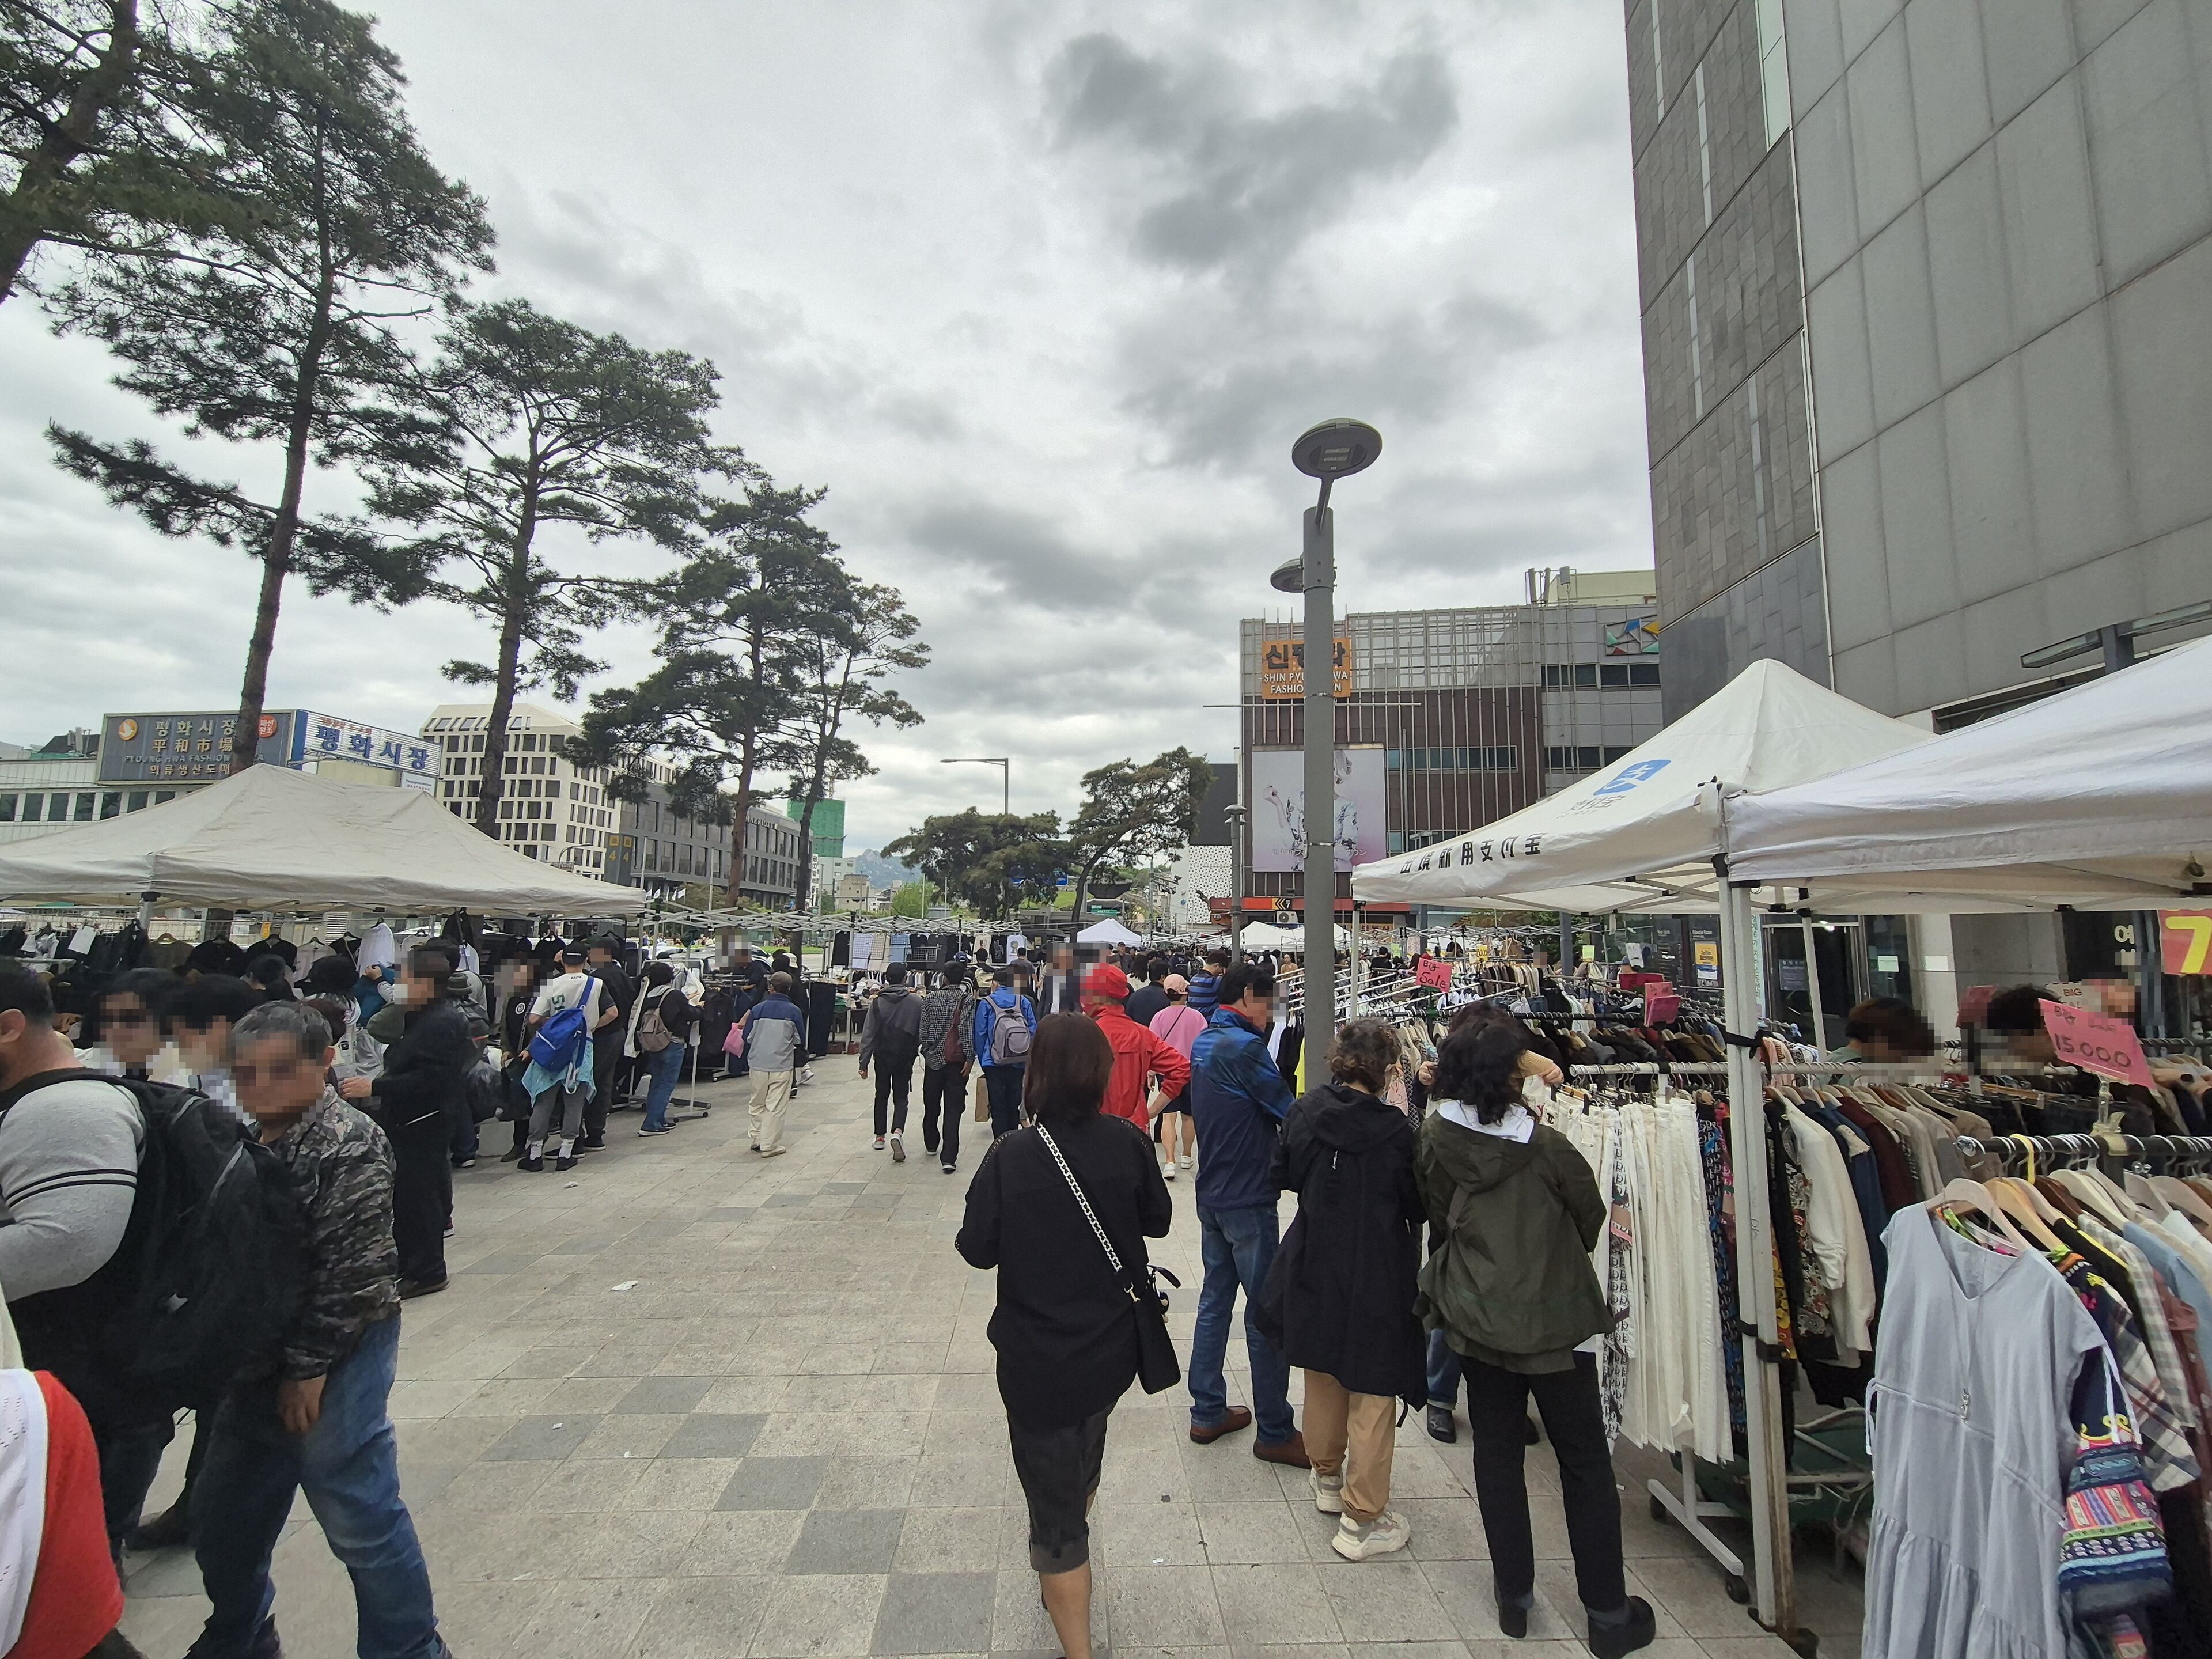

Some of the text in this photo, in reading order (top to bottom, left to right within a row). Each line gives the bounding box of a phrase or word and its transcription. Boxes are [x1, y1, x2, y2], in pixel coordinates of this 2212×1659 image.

[1264, 672, 1286, 683] SHIN
[1271, 684, 1304, 694] FASHIO
[155, 719, 237, 738] 평화시장
[152, 738, 234, 753] 平和市場
[316, 725, 430, 770] 평화시장
[189, 755, 231, 763] FASHION
[745, 815, 773, 830] MARRIOTT
[609, 850, 616, 861] 4
[623, 851, 629, 862] 4
[2165, 916, 2212, 974] 7
[1423, 960, 1441, 972] Big
[1419, 971, 1447, 989] Sale
[2063, 988, 2082, 997] BIG
